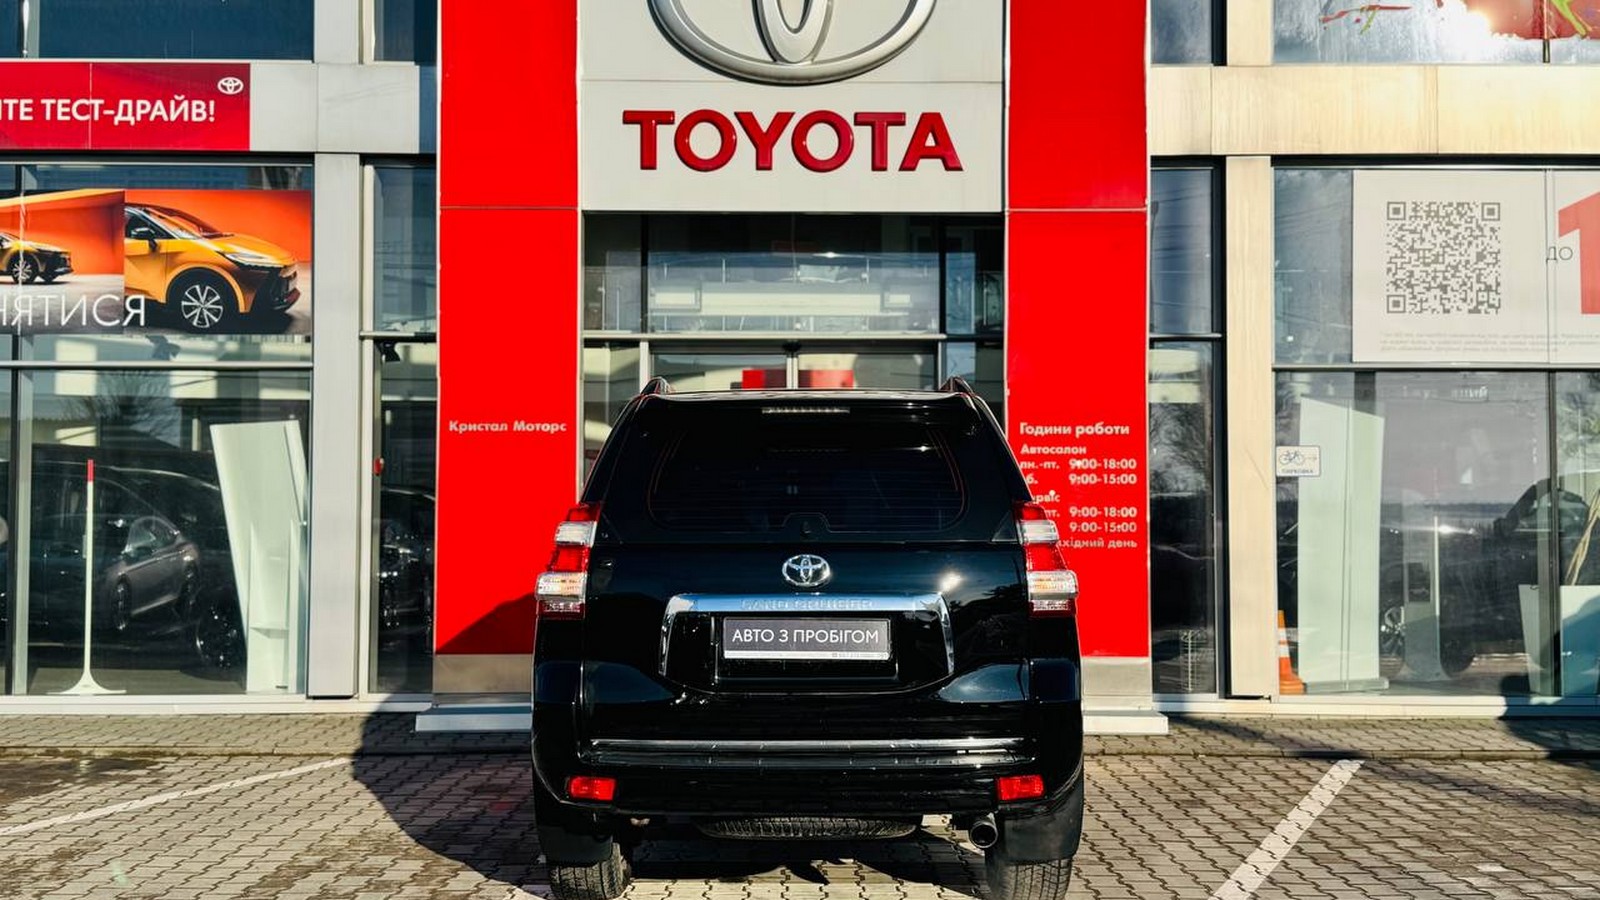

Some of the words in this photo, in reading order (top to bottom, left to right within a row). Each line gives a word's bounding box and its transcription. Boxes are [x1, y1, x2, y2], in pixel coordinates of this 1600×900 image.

[40, 95, 216, 126] ТЕСТ-ДРАЙВ!
[622, 109, 964, 173] TOYOTA
[449, 420, 508, 433] Кристал
[513, 420, 566, 433] Моторс
[1019, 422, 1072, 436] Години
[1075, 421, 1130, 438] роботи
[1020, 444, 1087, 455] Автосалон
[1068, 458, 1137, 470] 9:00-18:00
[1025, 474, 1038, 484] б.
[1068, 473, 1137, 485] 9:00-15:00
[1068, 507, 1137, 518] 9:00-18:00
[1068, 522, 1137, 533] 9:00-15:00
[1107, 540, 1137, 549] день
[731, 628, 775, 644] АВТО
[792, 629, 879, 644] ПРОБІГОМ
